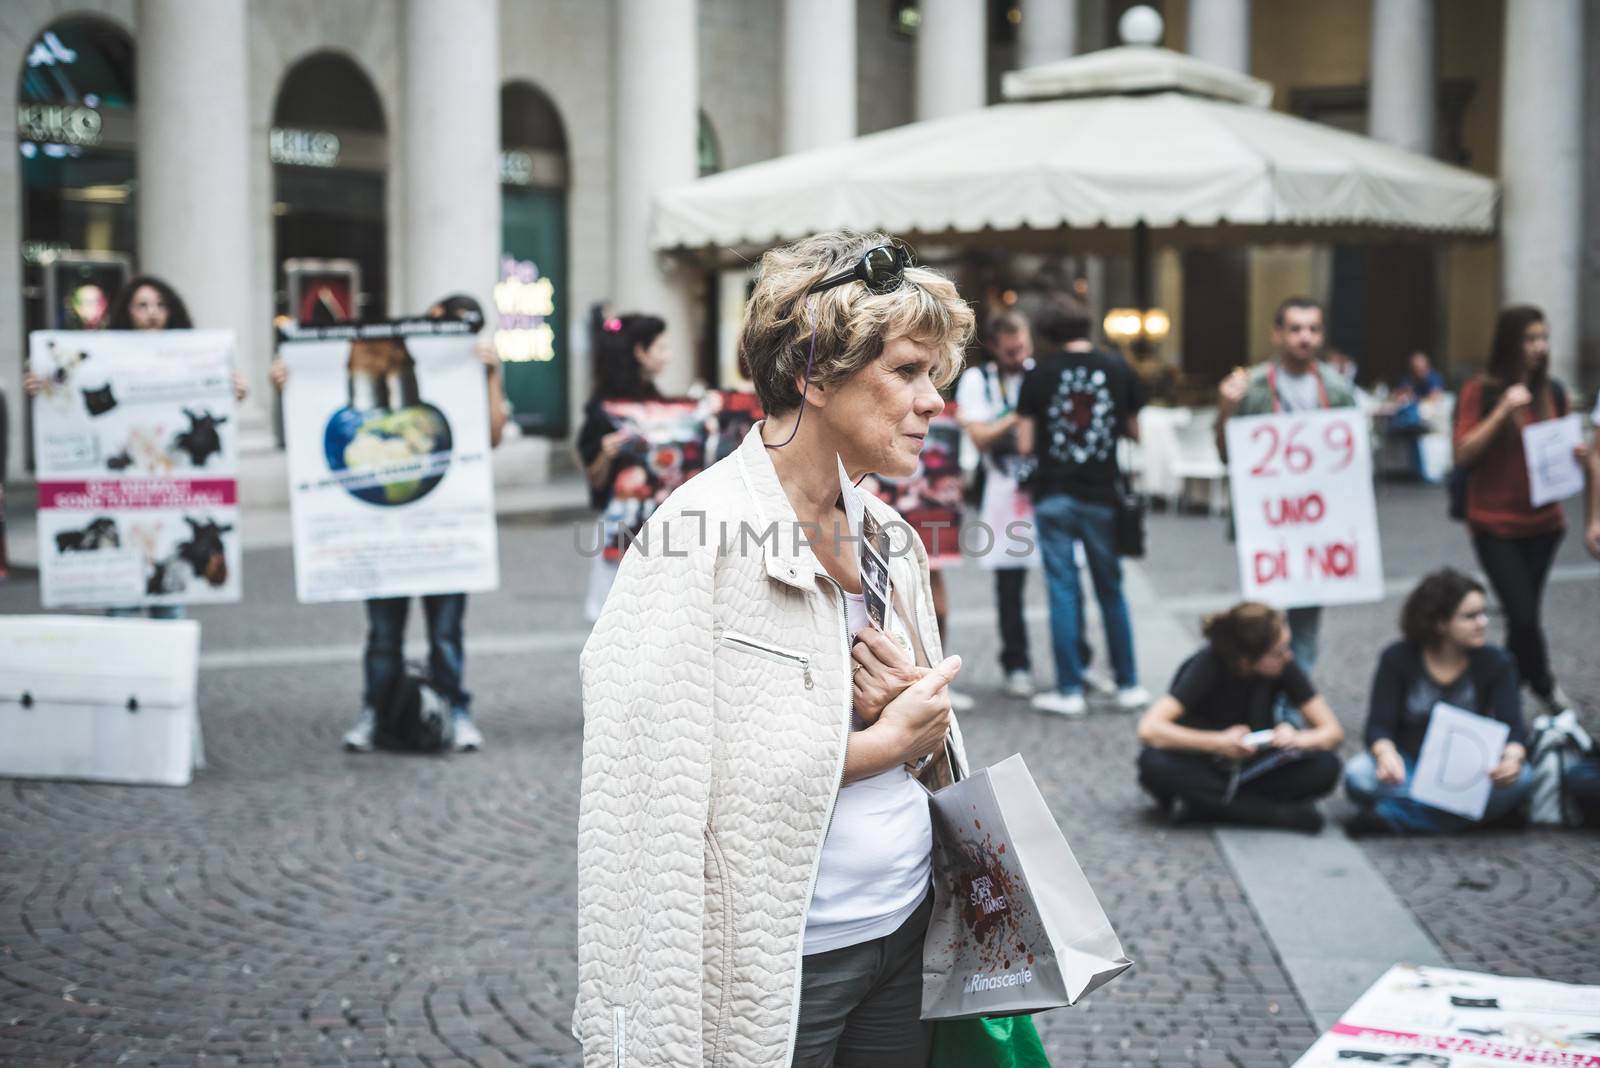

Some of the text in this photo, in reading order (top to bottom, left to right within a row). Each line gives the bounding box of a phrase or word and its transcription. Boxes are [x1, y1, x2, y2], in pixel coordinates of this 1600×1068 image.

[1264, 491, 1325, 527] UNO
[1434, 723, 1490, 793] D
[971, 968, 1032, 992] Rinascente
